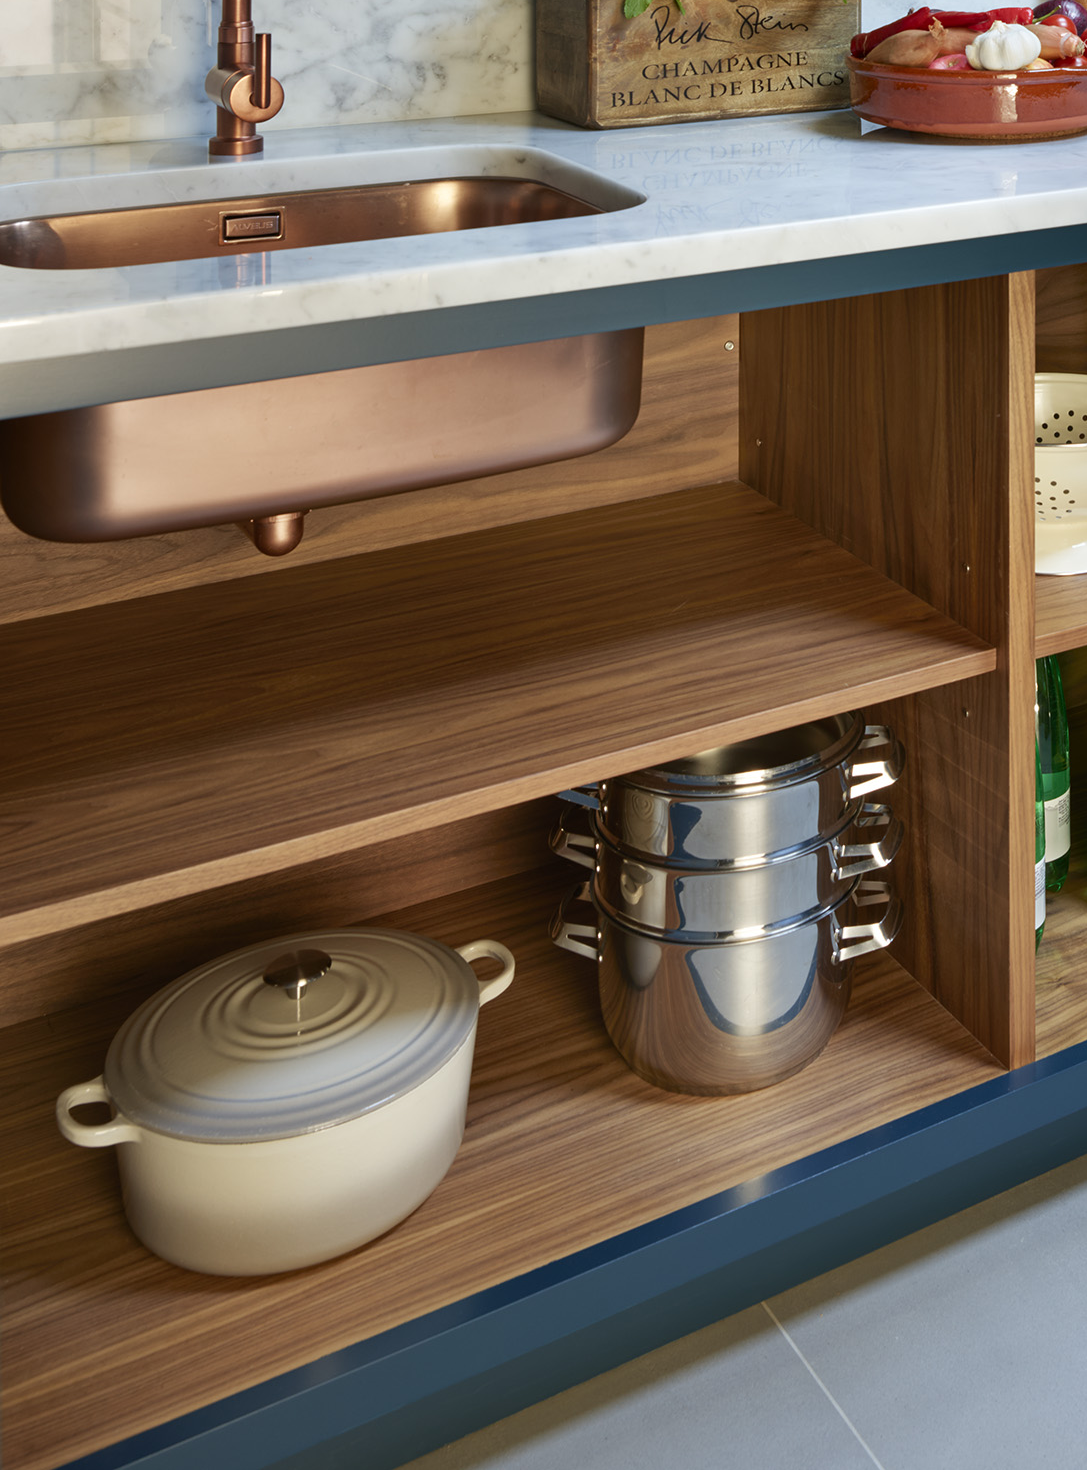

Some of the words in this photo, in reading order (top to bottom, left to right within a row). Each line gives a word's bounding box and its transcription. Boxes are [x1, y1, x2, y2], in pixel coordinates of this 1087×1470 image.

[641, 50, 808, 81] CHAMPAGNE
[611, 84, 702, 109] BLANC
[710, 80, 743, 99] DE
[750, 70, 844, 94] BLANCS
